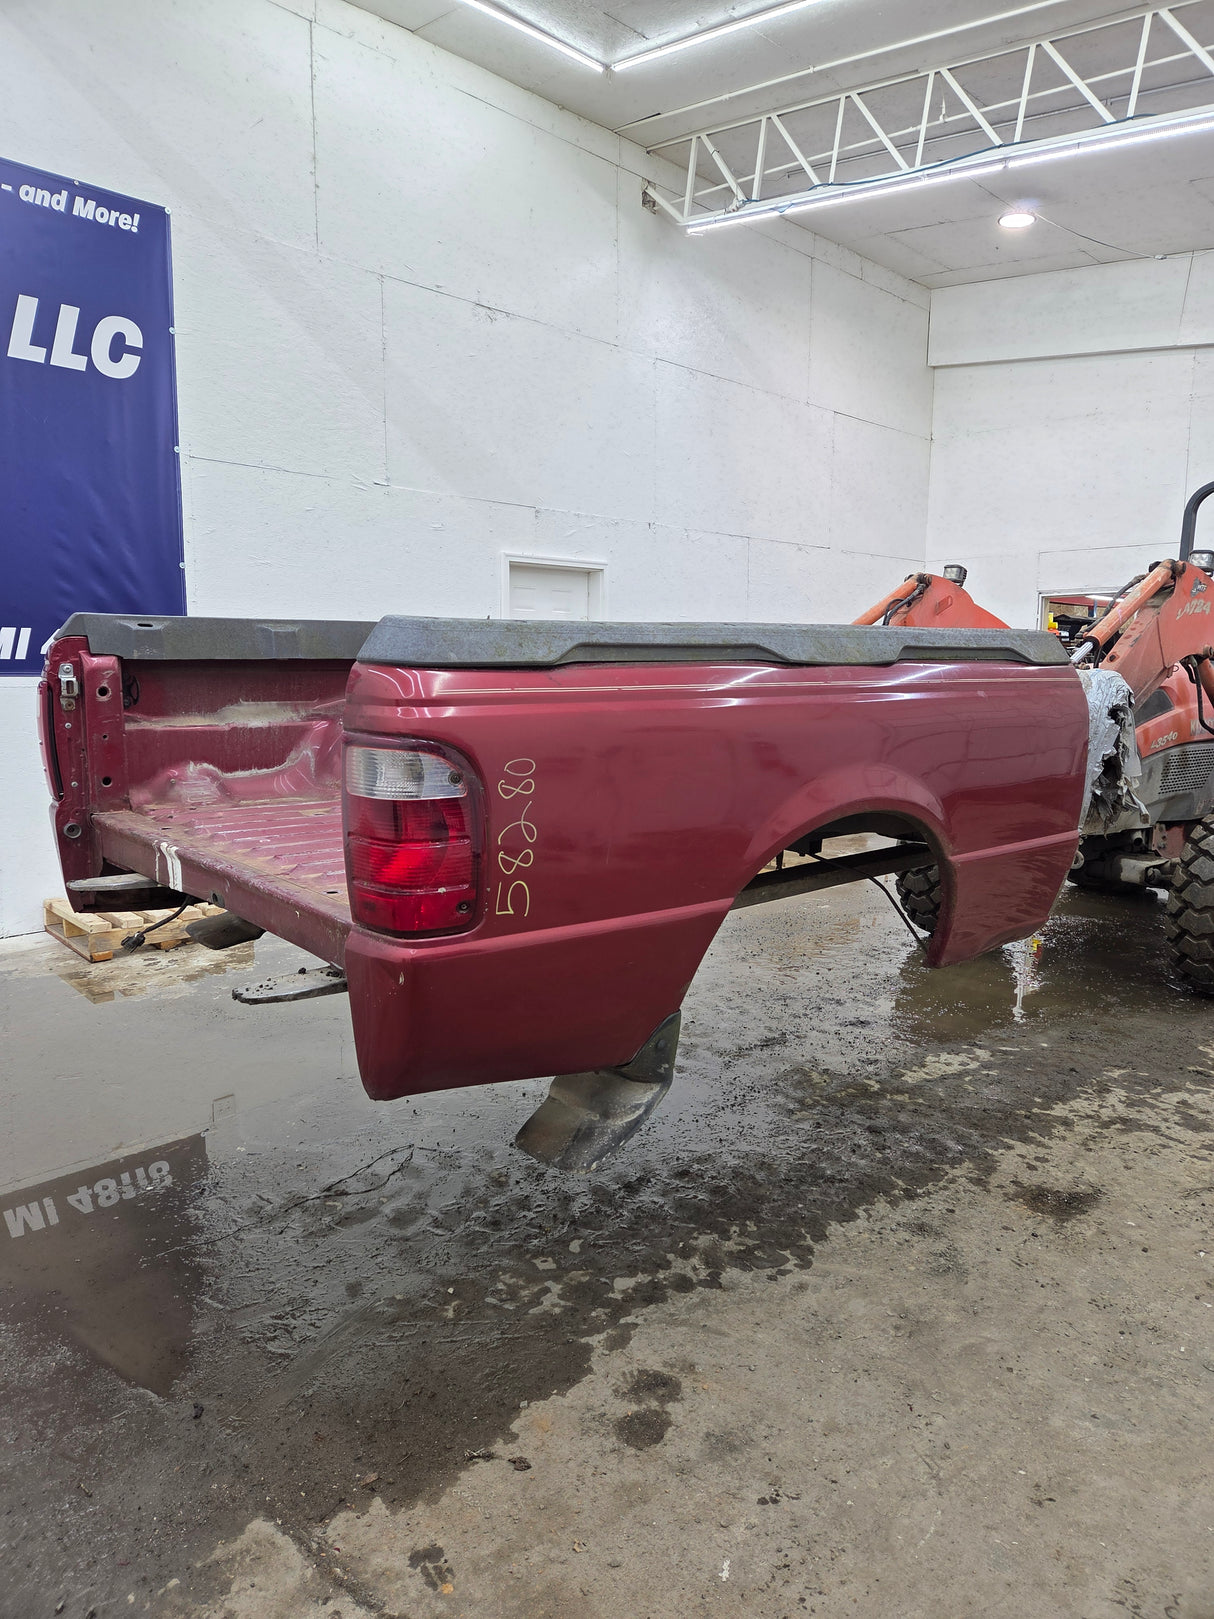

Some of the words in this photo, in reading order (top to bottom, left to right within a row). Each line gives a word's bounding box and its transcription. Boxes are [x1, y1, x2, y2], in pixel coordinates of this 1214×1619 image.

[19, 184, 68, 212] and
[72, 196, 141, 233] More!
[7, 294, 144, 379] LLC
[496, 758, 538, 917] 58280
